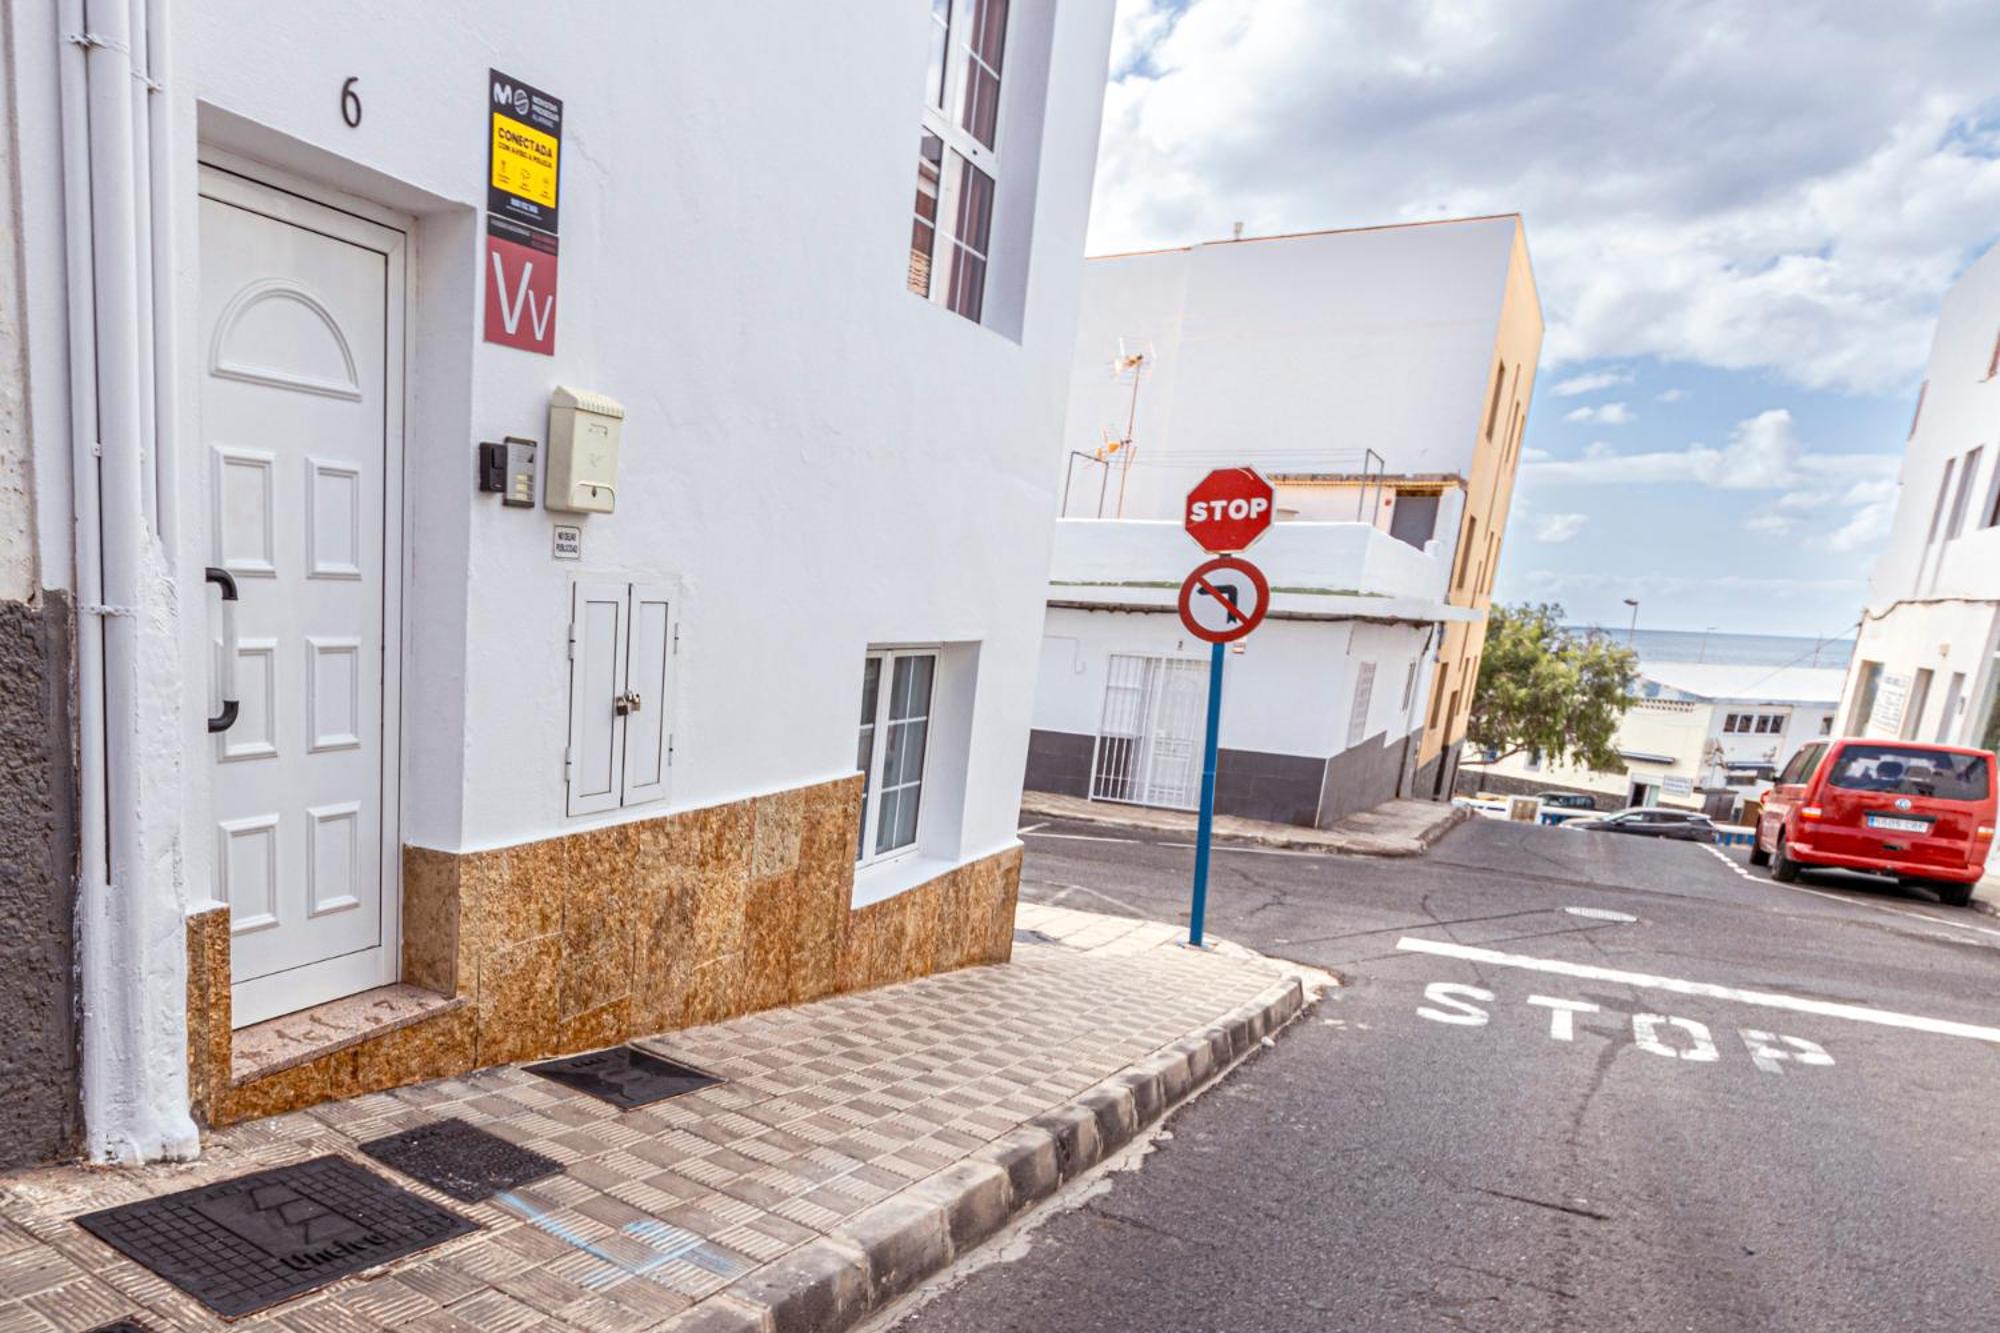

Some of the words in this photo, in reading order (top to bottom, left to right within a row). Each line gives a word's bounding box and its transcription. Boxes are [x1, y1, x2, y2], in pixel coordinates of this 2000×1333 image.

[341, 76, 361, 128] 6
[498, 127, 553, 158] CONECTADA
[1190, 497, 1268, 523] STOP
[1416, 981, 1836, 1075] STOP
